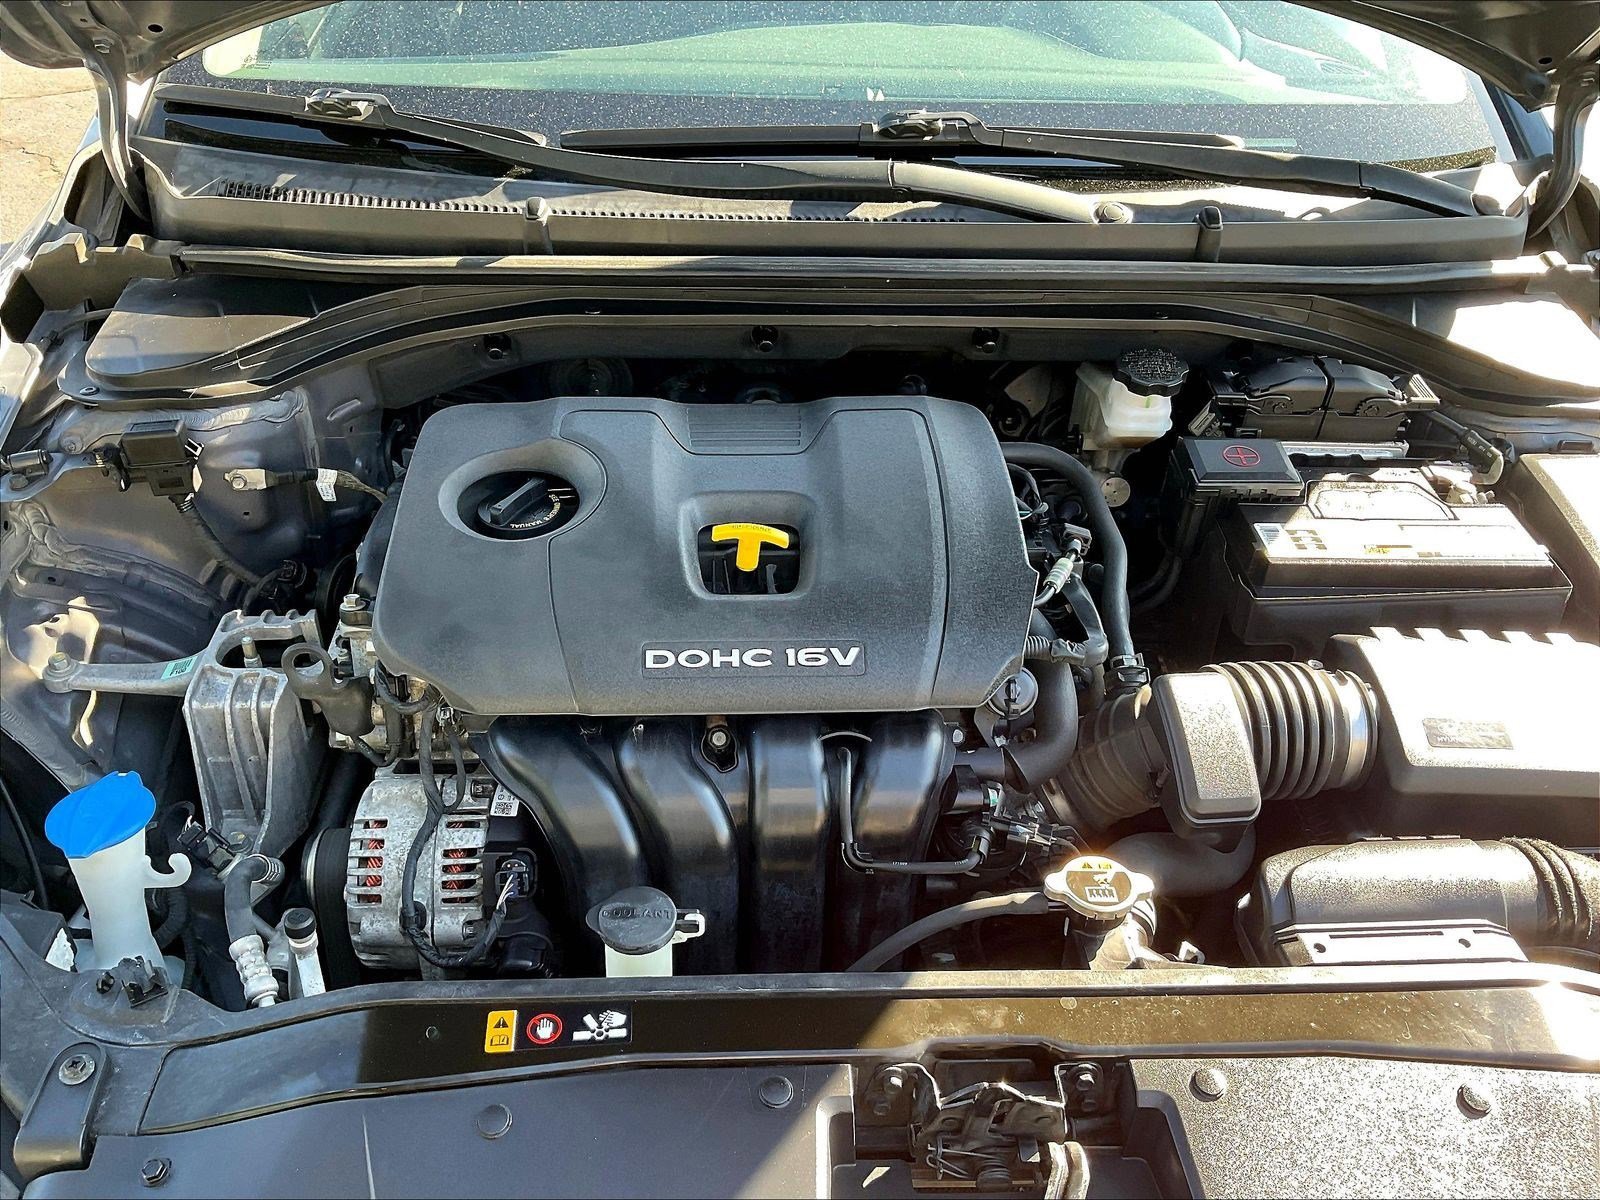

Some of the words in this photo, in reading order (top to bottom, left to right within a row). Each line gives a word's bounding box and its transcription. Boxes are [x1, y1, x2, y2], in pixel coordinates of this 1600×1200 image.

[510, 520, 543, 529] MANUAL
[645, 648, 773, 669] DOHC
[785, 646, 860, 667] 16V
[602, 908, 672, 919] COOLANT
